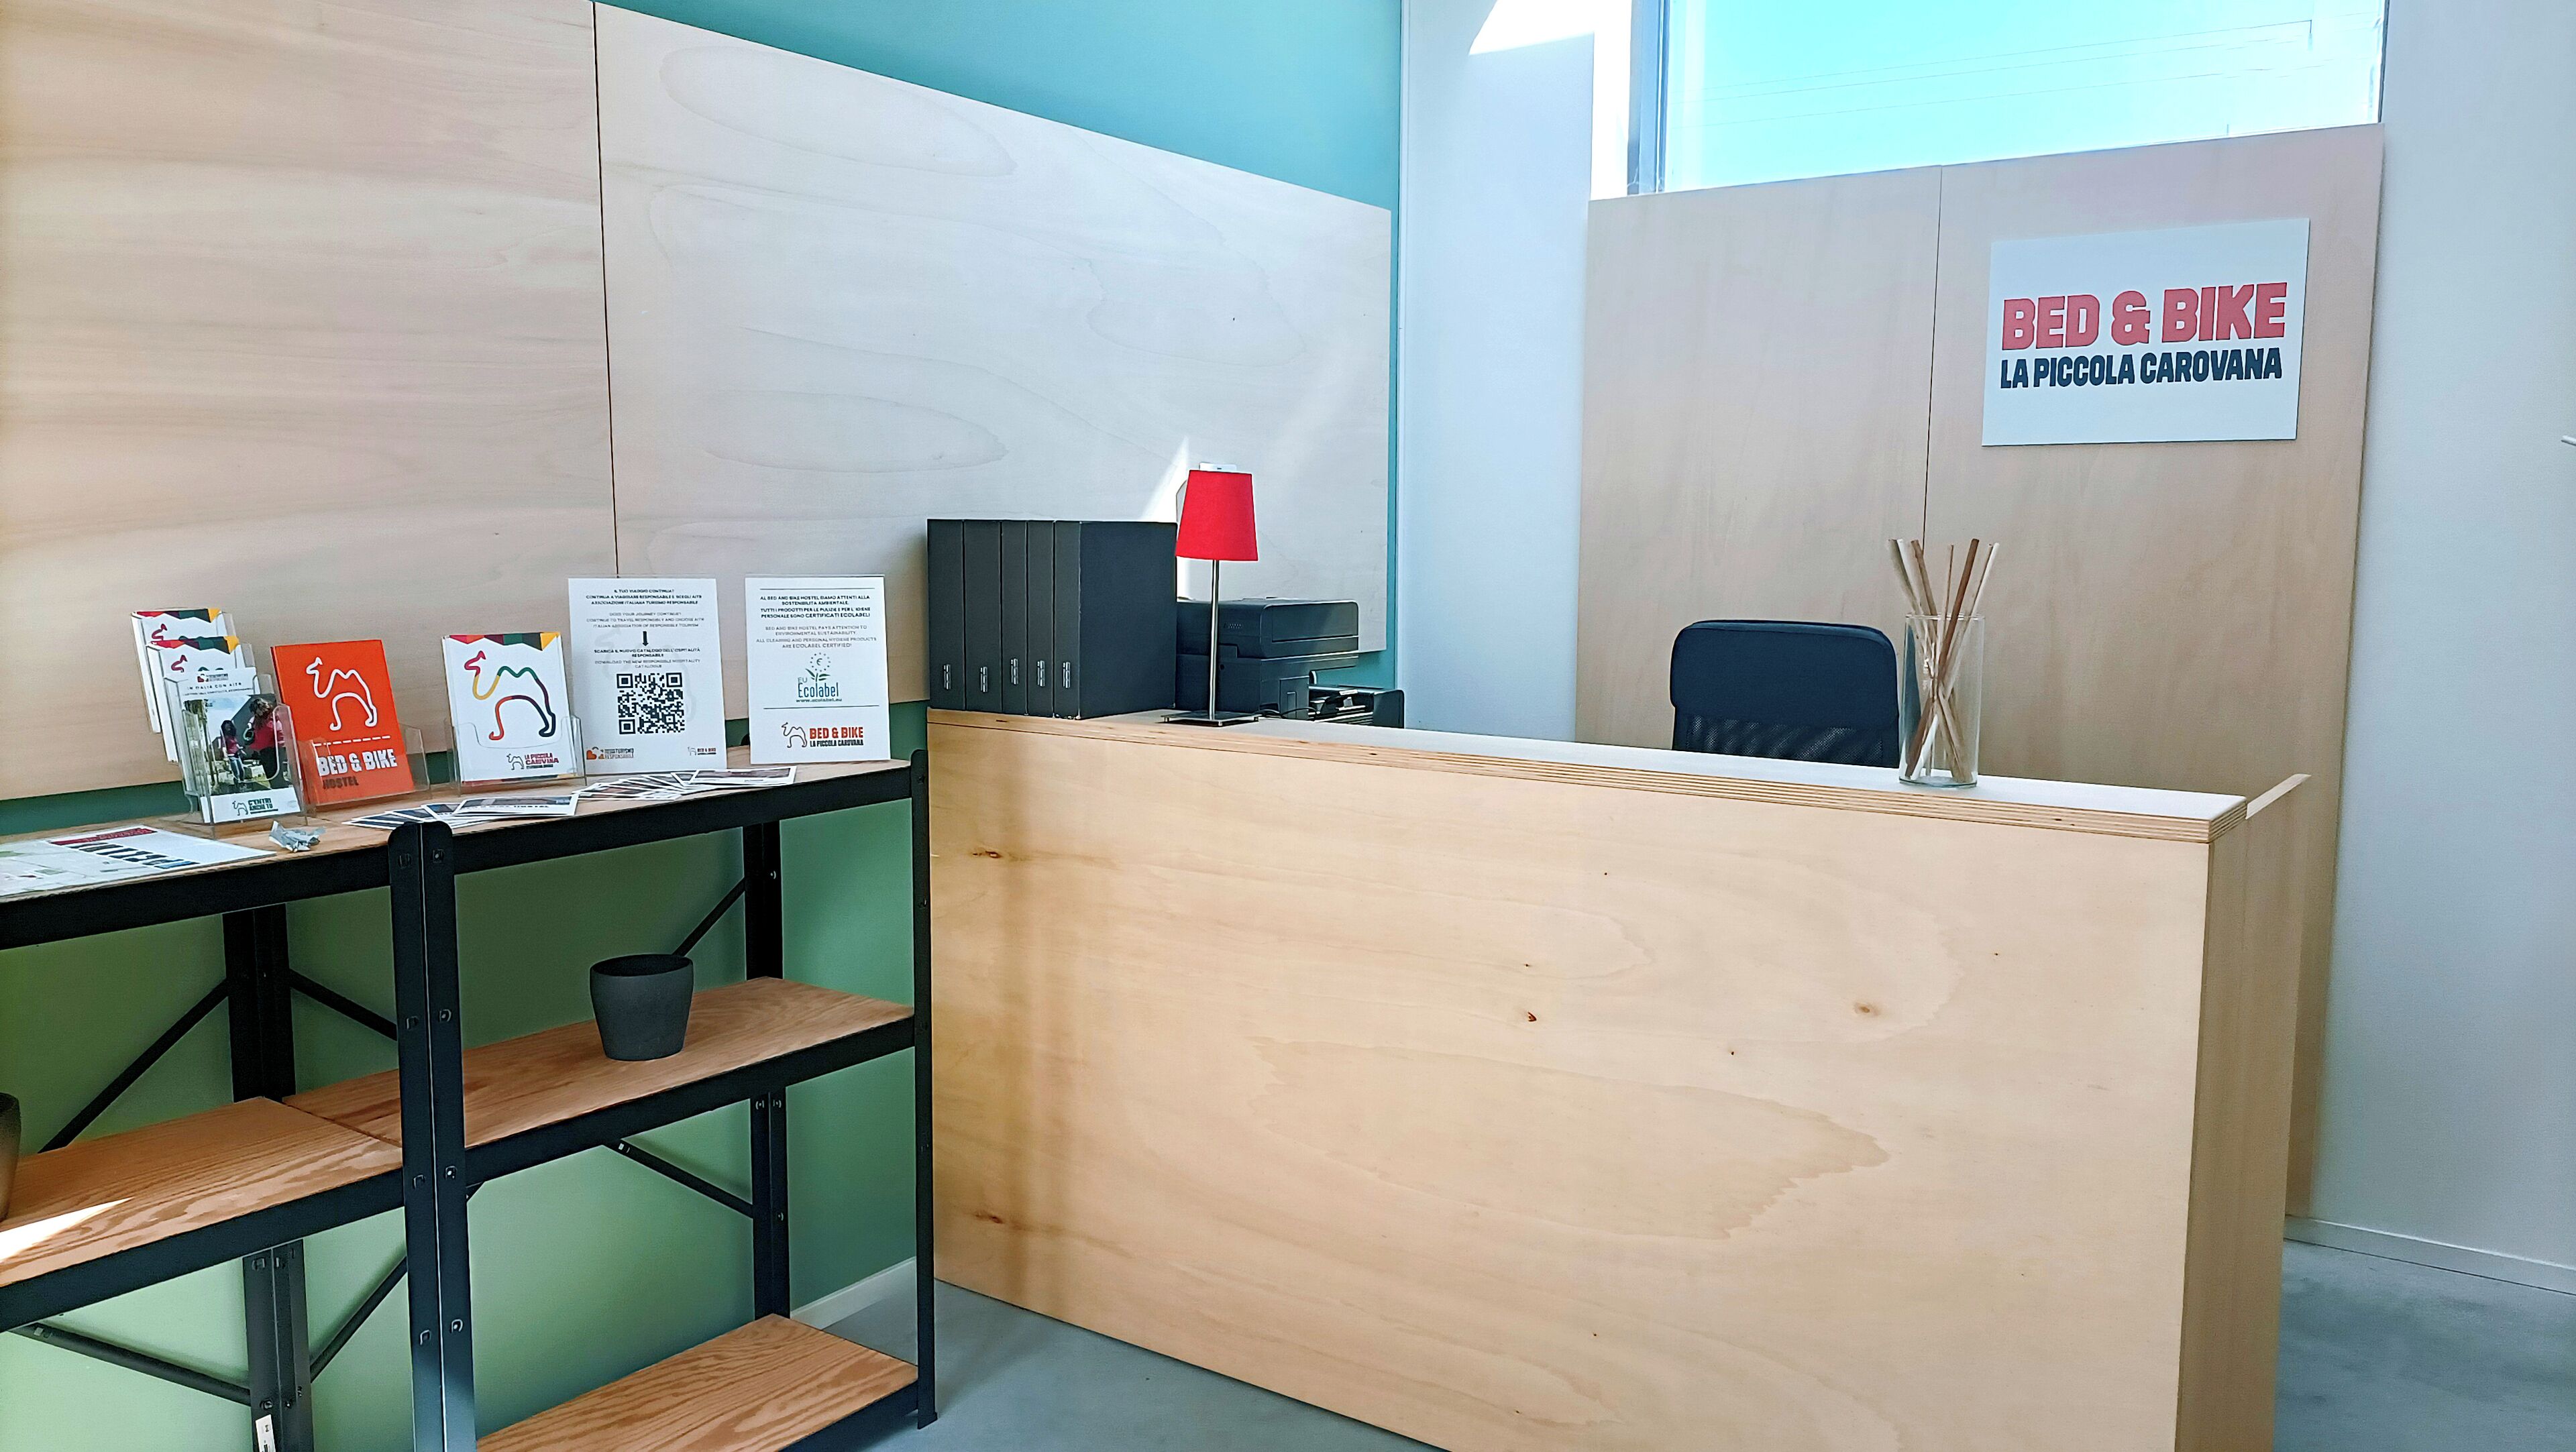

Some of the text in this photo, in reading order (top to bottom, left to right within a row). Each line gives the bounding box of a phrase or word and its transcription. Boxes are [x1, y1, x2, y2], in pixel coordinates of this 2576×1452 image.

[2002, 282, 2287, 350] BED & BIKE
[2001, 347, 2282, 388] LA PICCOLA CAROVANA
[798, 682, 839, 697] Ecolabel
[810, 727, 863, 739] BED & BIKE
[318, 749, 397, 777] BED & BIKE
